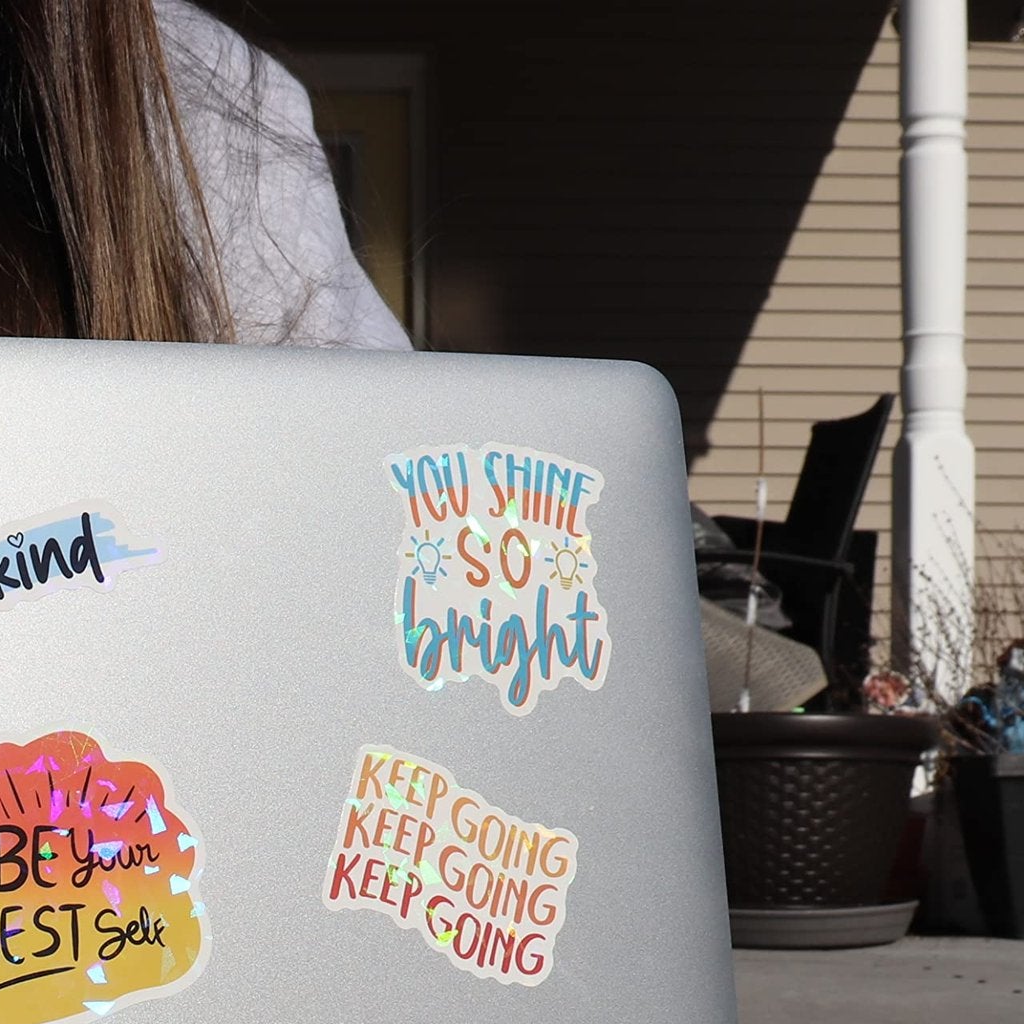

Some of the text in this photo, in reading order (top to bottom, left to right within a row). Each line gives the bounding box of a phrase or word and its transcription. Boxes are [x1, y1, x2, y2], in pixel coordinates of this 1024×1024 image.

[390, 452, 596, 538] YOU SHINE
[457, 526, 532, 589] SO
[402, 576, 603, 706] bright
[343, 802, 559, 926] KEEP GOING
[356, 753, 570, 878] KEEP GOING
[329, 853, 546, 975] KEEP GOING
